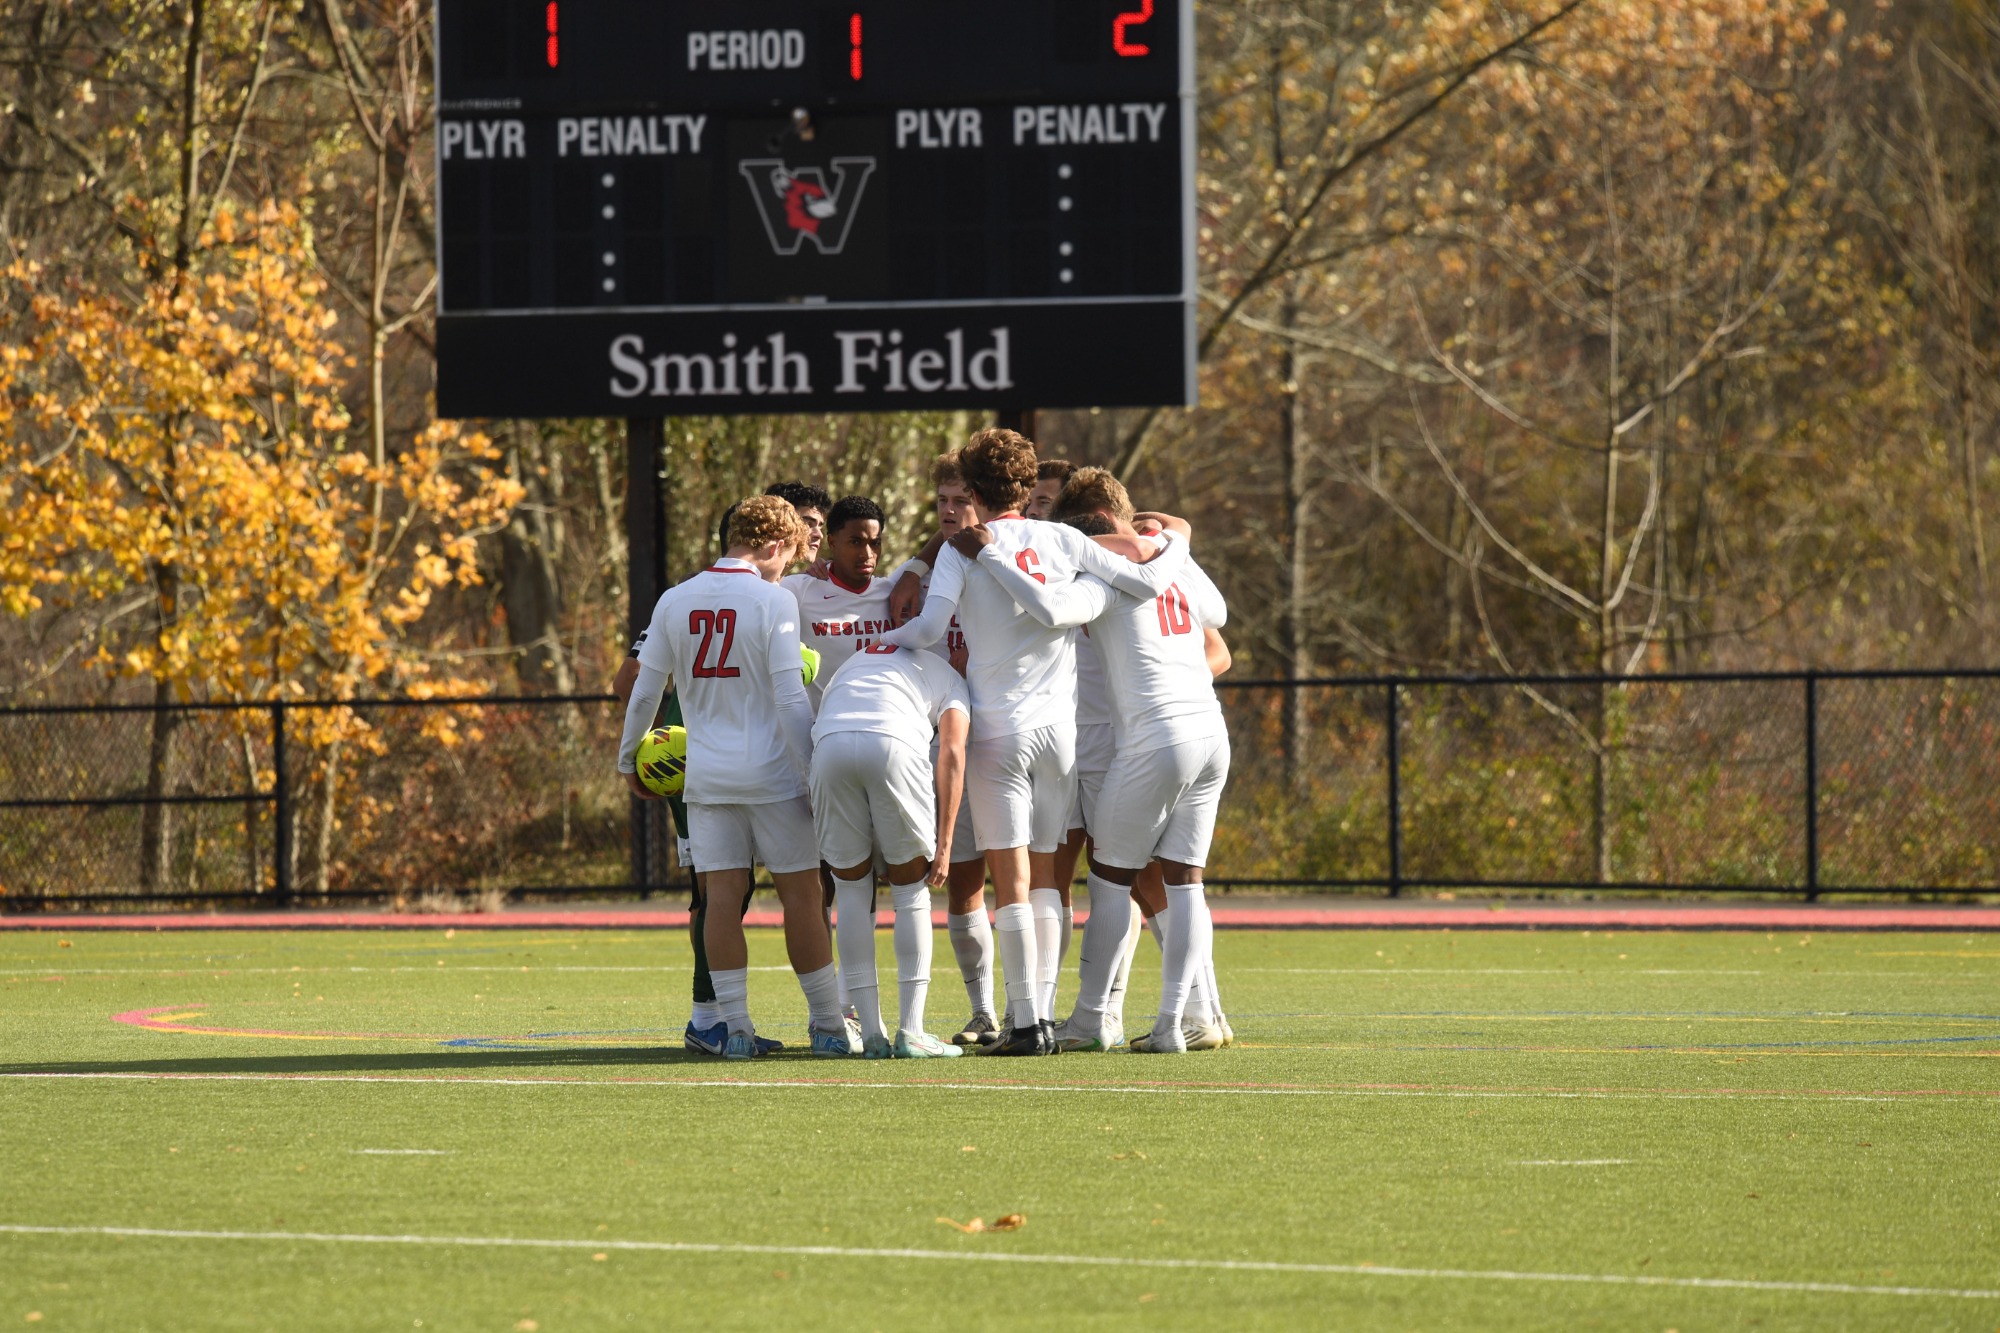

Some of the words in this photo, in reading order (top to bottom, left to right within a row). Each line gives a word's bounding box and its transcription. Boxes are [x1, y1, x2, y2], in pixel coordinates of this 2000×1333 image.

[545, 1, 559, 68] 1
[687, 30, 805, 70] PERIOD
[849, 13, 863, 81] 1
[1112, 0, 1154, 57] 2
[442, 121, 526, 159] PLYR
[557, 115, 707, 156] PENALTY
[896, 108, 983, 148] PLYR
[1013, 104, 1166, 145] PENALTY
[609, 333, 813, 397] Smith
[835, 328, 1013, 393] Field
[1156, 581, 1192, 637] 10
[689, 609, 740, 678] 22
